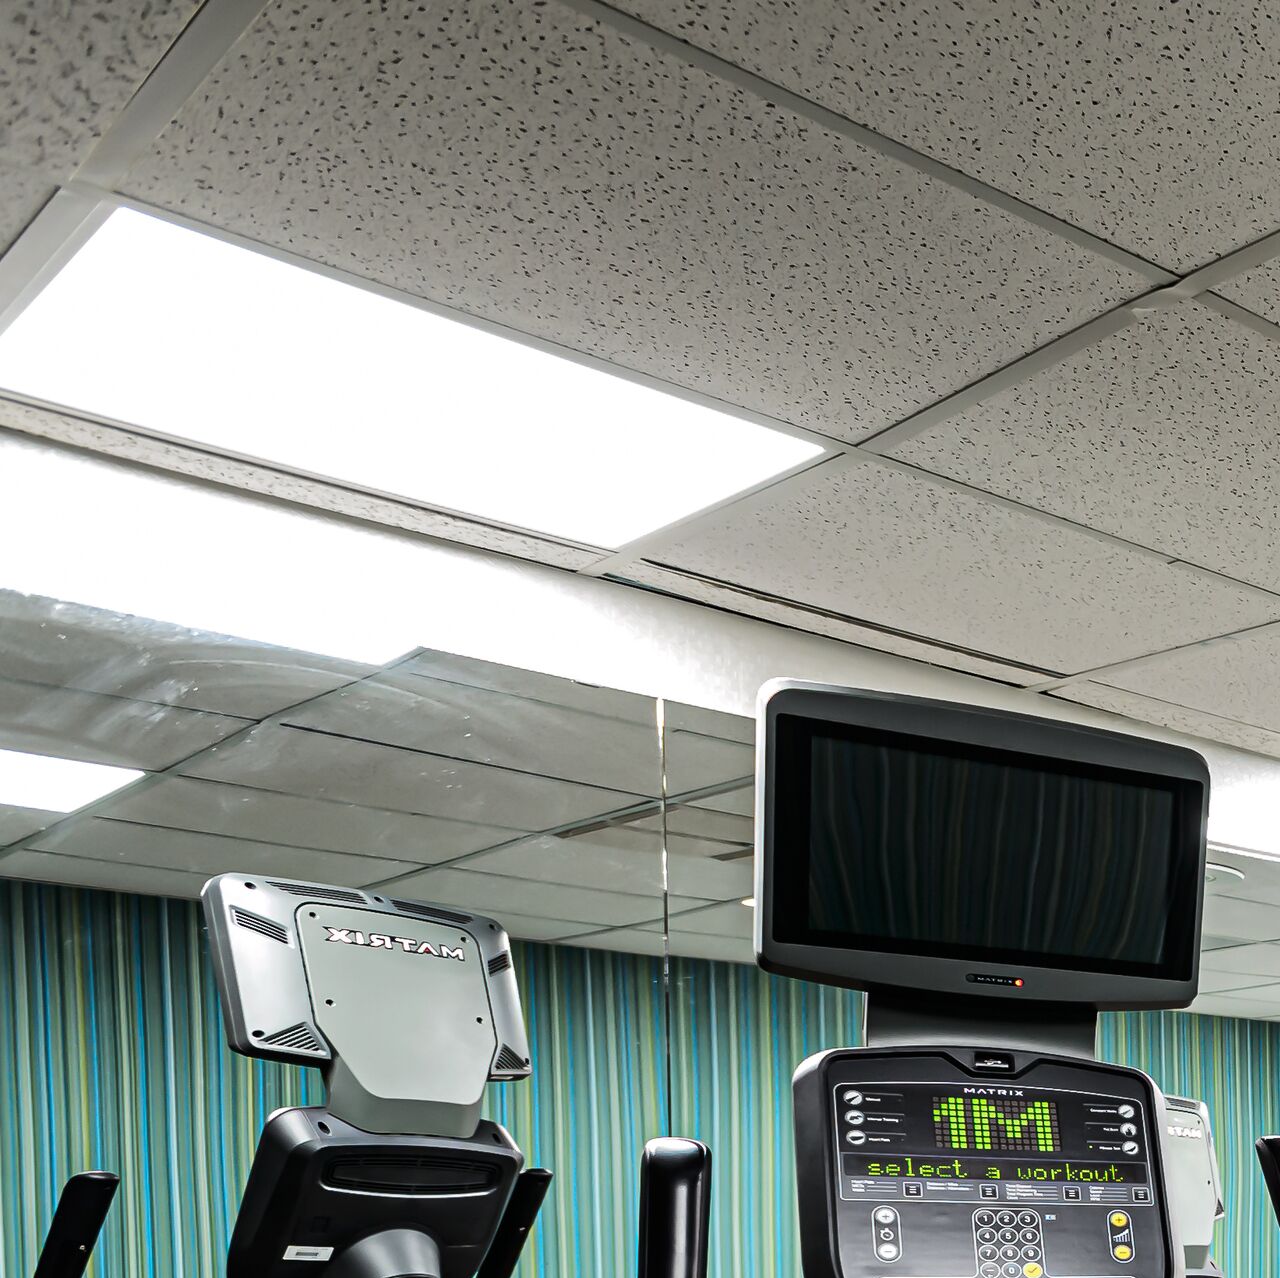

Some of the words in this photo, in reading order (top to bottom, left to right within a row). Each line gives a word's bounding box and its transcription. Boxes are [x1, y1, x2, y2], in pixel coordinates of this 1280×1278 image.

[963, 1087, 1024, 1097] MATRIX
[933, 1096, 1054, 1152] 1M
[867, 1157, 968, 1179] select
[985, 1166, 1001, 1180] a
[1017, 1163, 1124, 1183] workout
